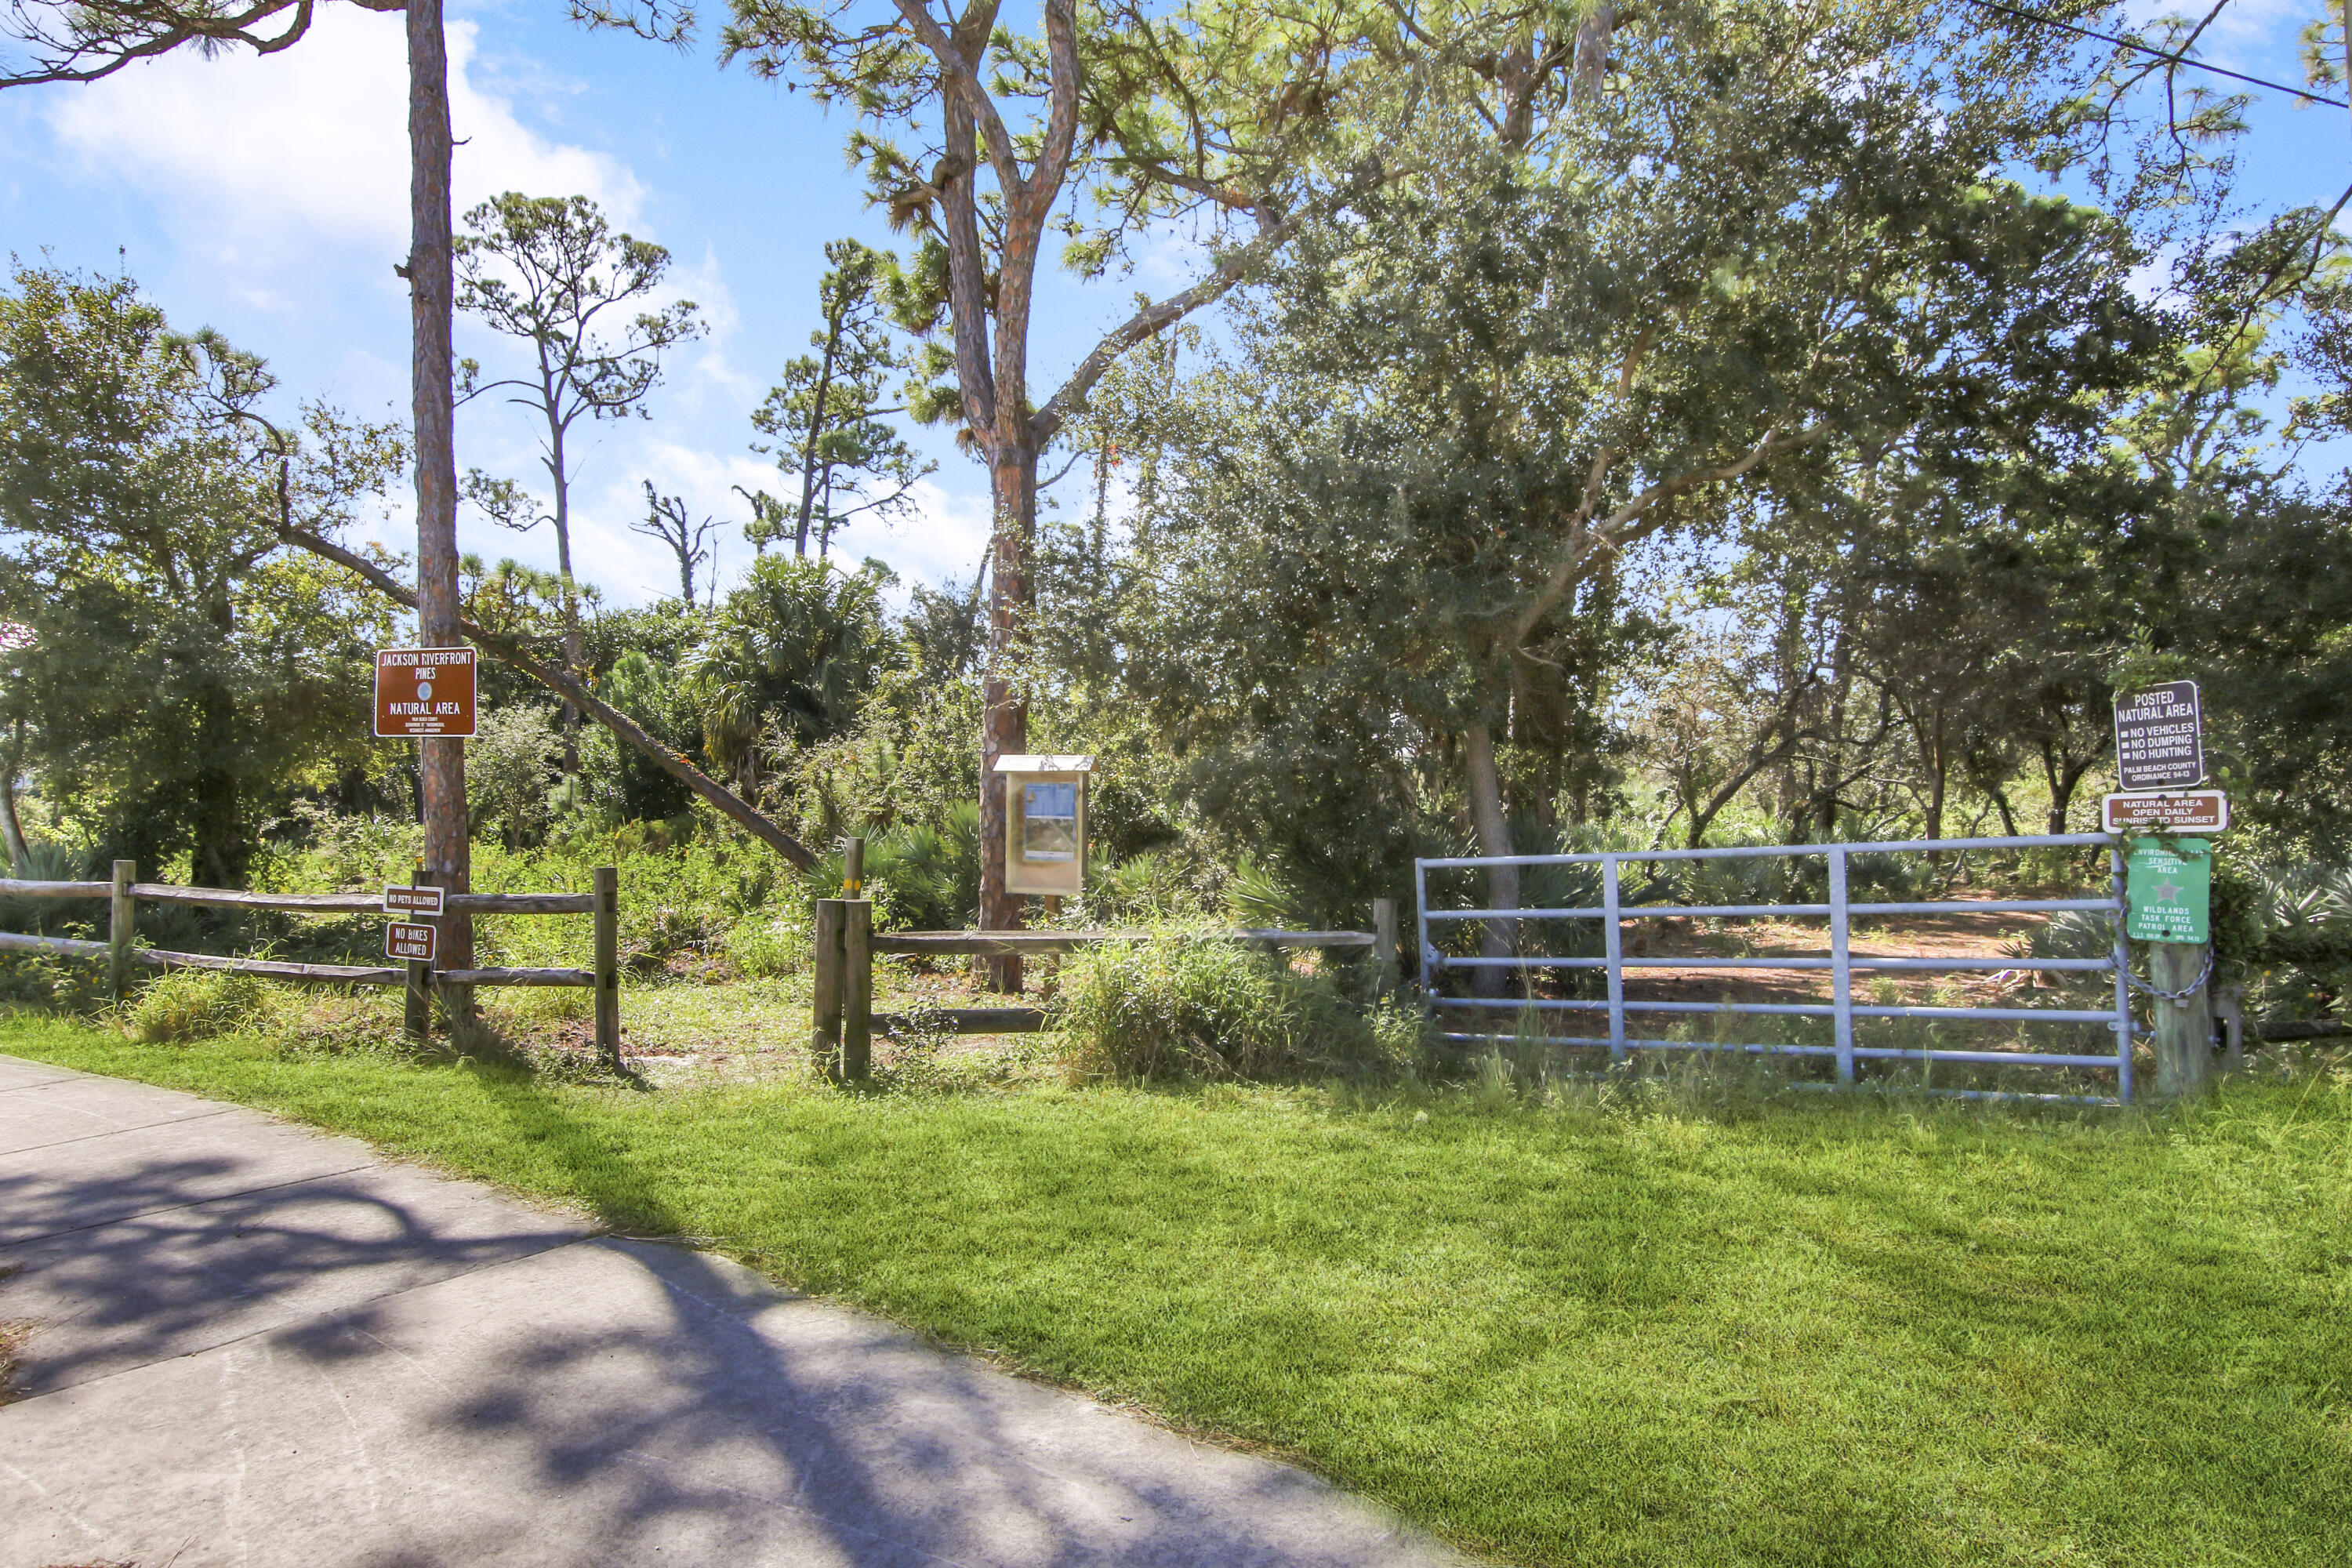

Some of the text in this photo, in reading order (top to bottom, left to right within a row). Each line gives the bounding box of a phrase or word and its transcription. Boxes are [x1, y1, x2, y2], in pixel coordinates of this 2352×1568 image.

[382, 652, 471, 666] JACKSON RIVERFRONT
[415, 667, 436, 680] PINES
[2135, 691, 2174, 706] POSTED
[390, 702, 460, 715] NATURAL AREA
[2118, 702, 2194, 723] NATURAL AREA
[2130, 723, 2194, 738] NO VEHICLES
[2131, 734, 2192, 749] NO DUMPING
[2132, 746, 2192, 760] NO HUNTING
[2123, 761, 2196, 774] PALM BEACH COUNTY
[2132, 770, 2190, 781] ORDINANCE 94-13
[2173, 815, 2215, 824] SUNSET
[388, 895, 438, 906] NO PETS ALLOWED
[2143, 906, 2190, 915] WILDLANDS
[2165, 915, 2191, 924] FORCE
[2138, 922, 2166, 931] PATROL
[395, 927, 428, 941] NO BIKES
[395, 942, 426, 956] ALLOWED
